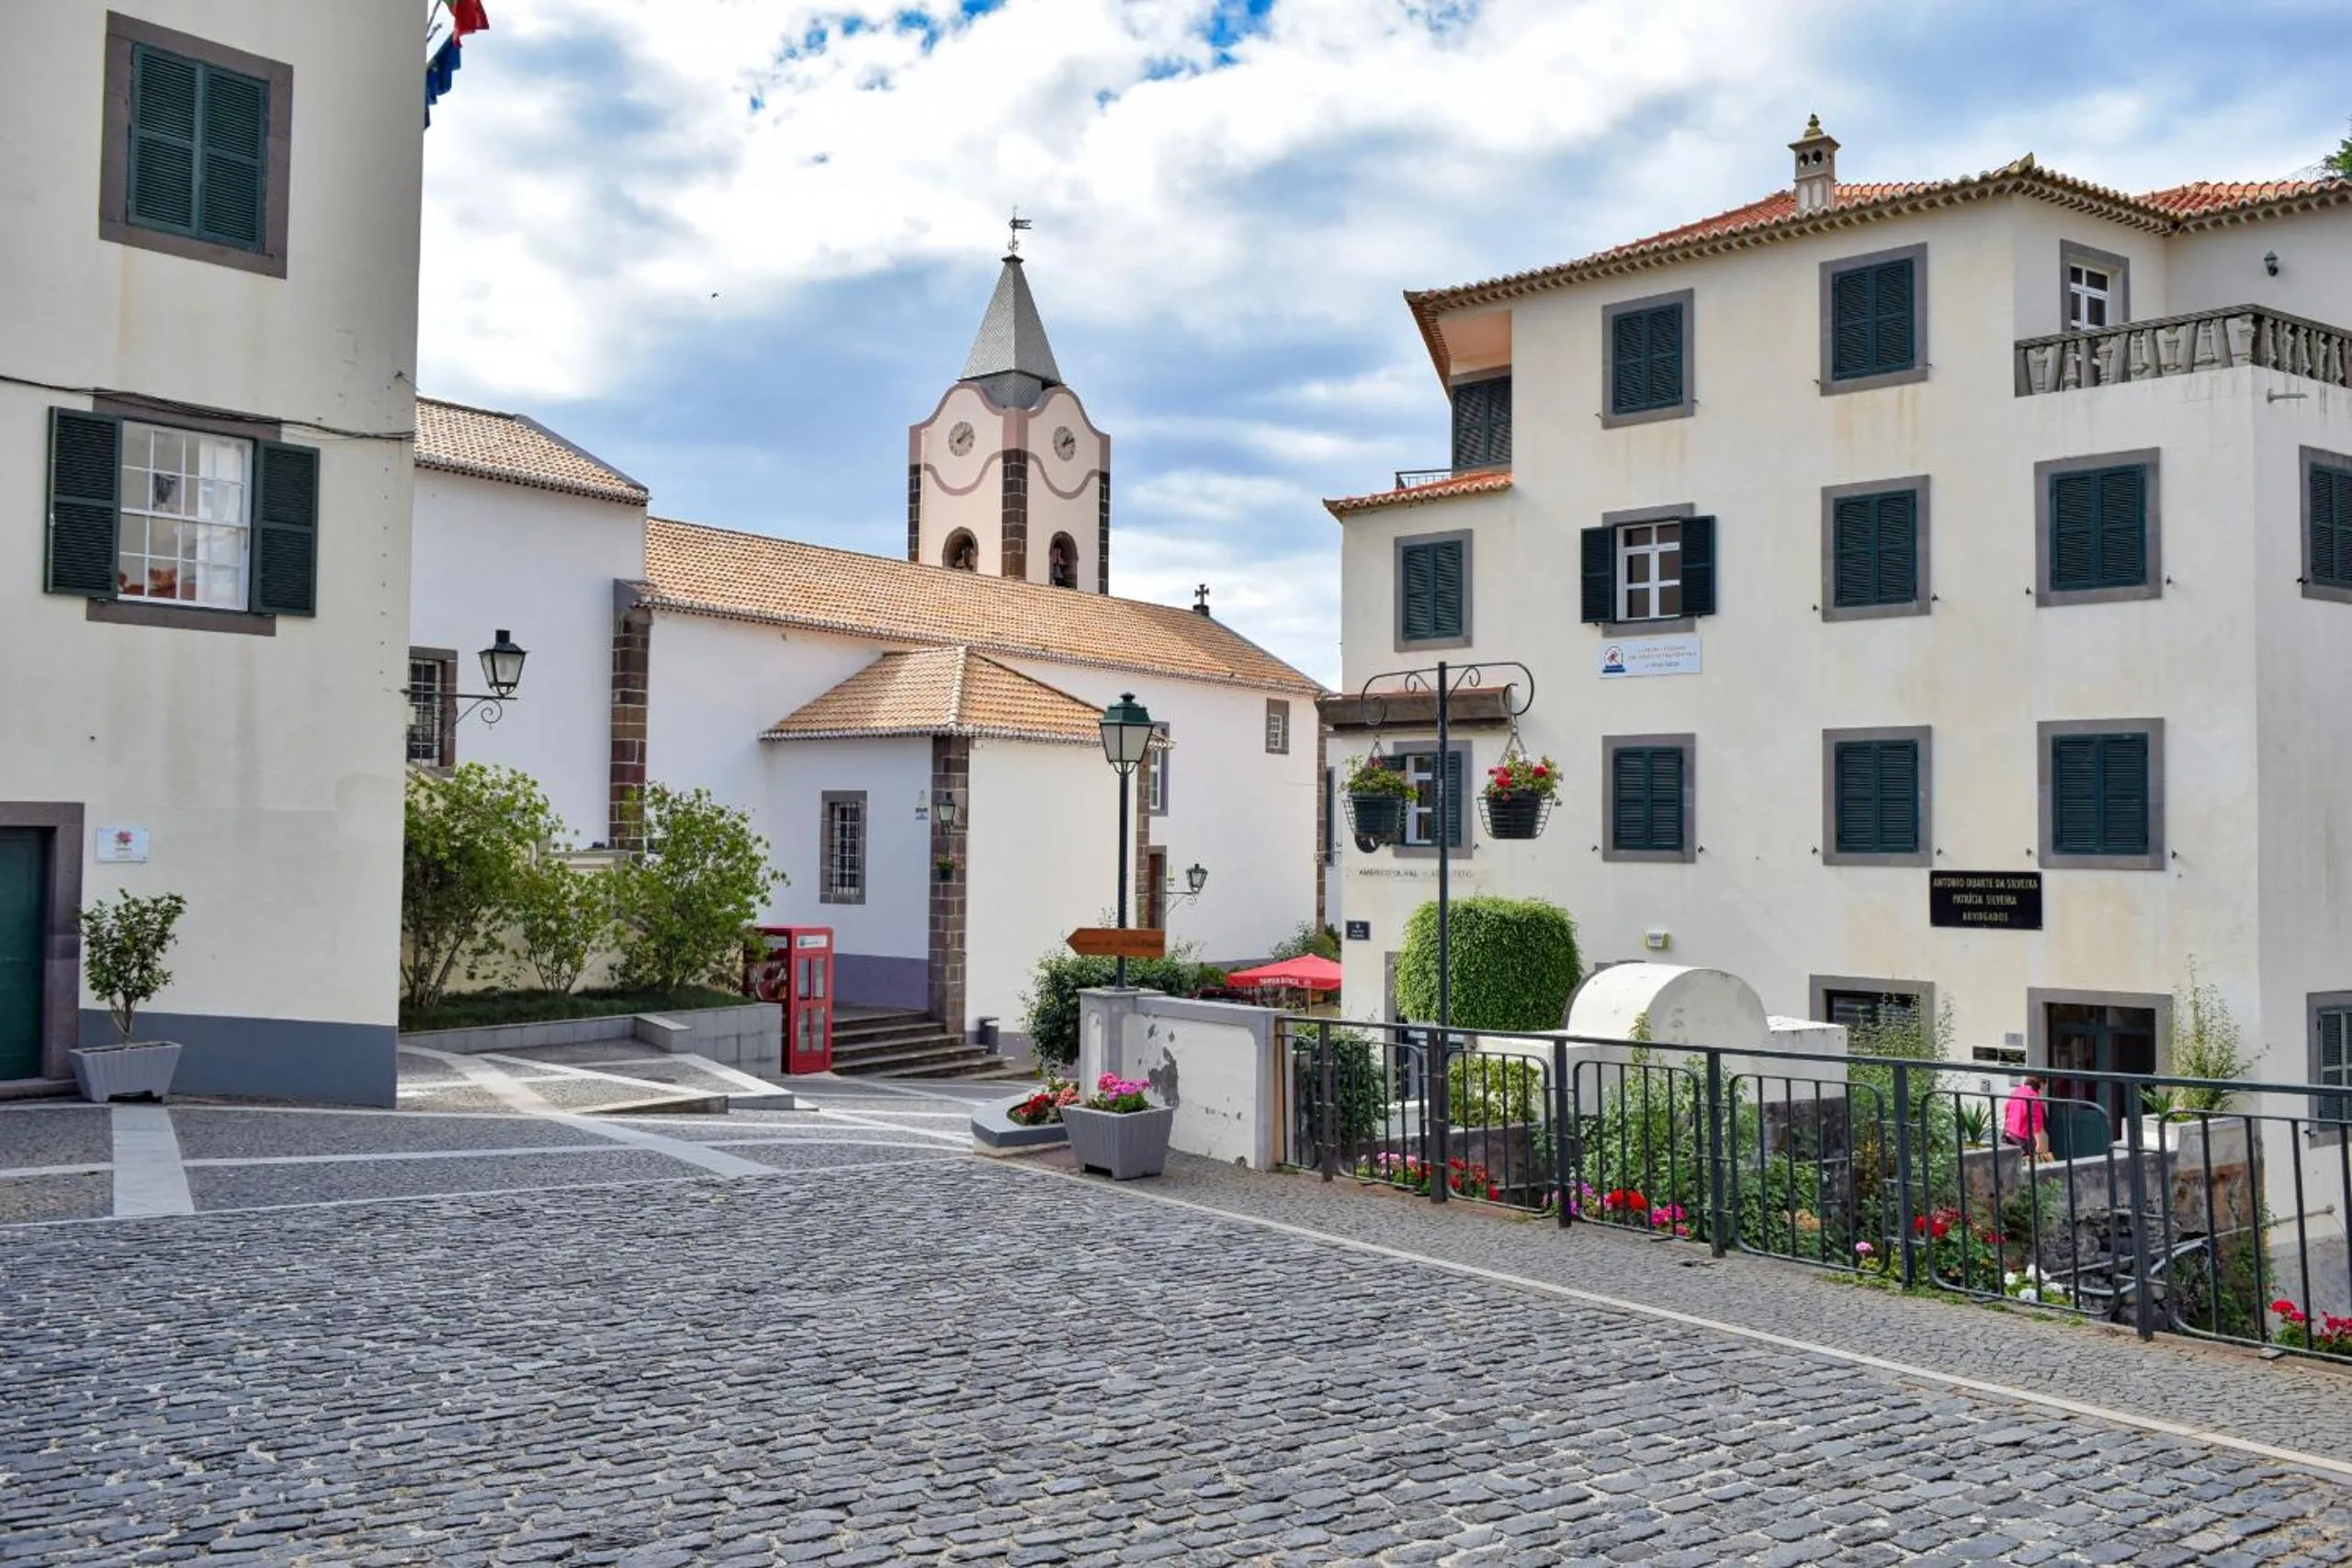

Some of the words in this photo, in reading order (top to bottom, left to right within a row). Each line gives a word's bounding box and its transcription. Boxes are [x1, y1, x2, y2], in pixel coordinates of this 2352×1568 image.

[1966, 877, 1994, 888] DUARTE
[1996, 878, 2006, 888] DA
[2007, 878, 2039, 889] SILVEIRA
[1986, 895, 2018, 905] SILVEIRA
